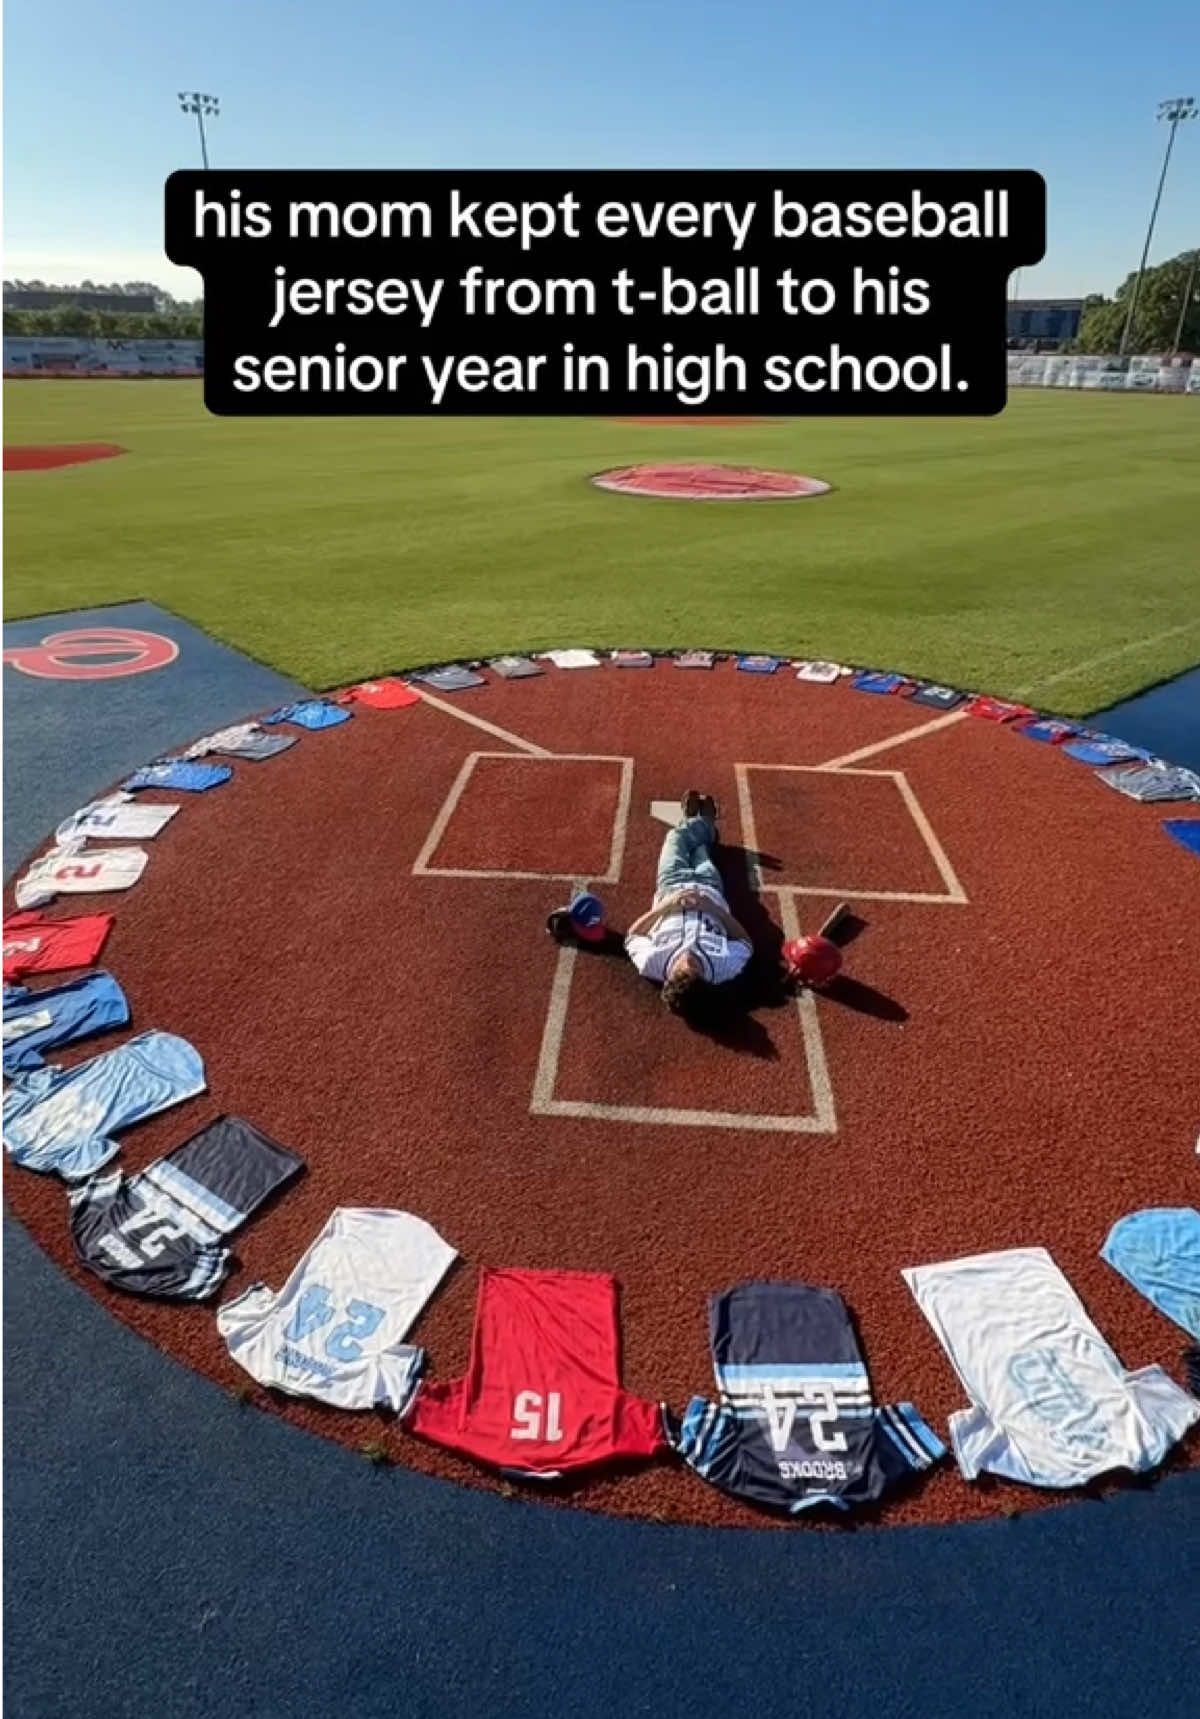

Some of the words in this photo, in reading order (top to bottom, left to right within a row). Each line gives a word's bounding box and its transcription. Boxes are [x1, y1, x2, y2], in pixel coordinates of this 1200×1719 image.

[55, 862, 103, 881] 2
[283, 1284, 386, 1362] 24
[511, 1389, 564, 1443] 15
[761, 1383, 849, 1452] 24
[777, 1460, 848, 1481] BROOKS
